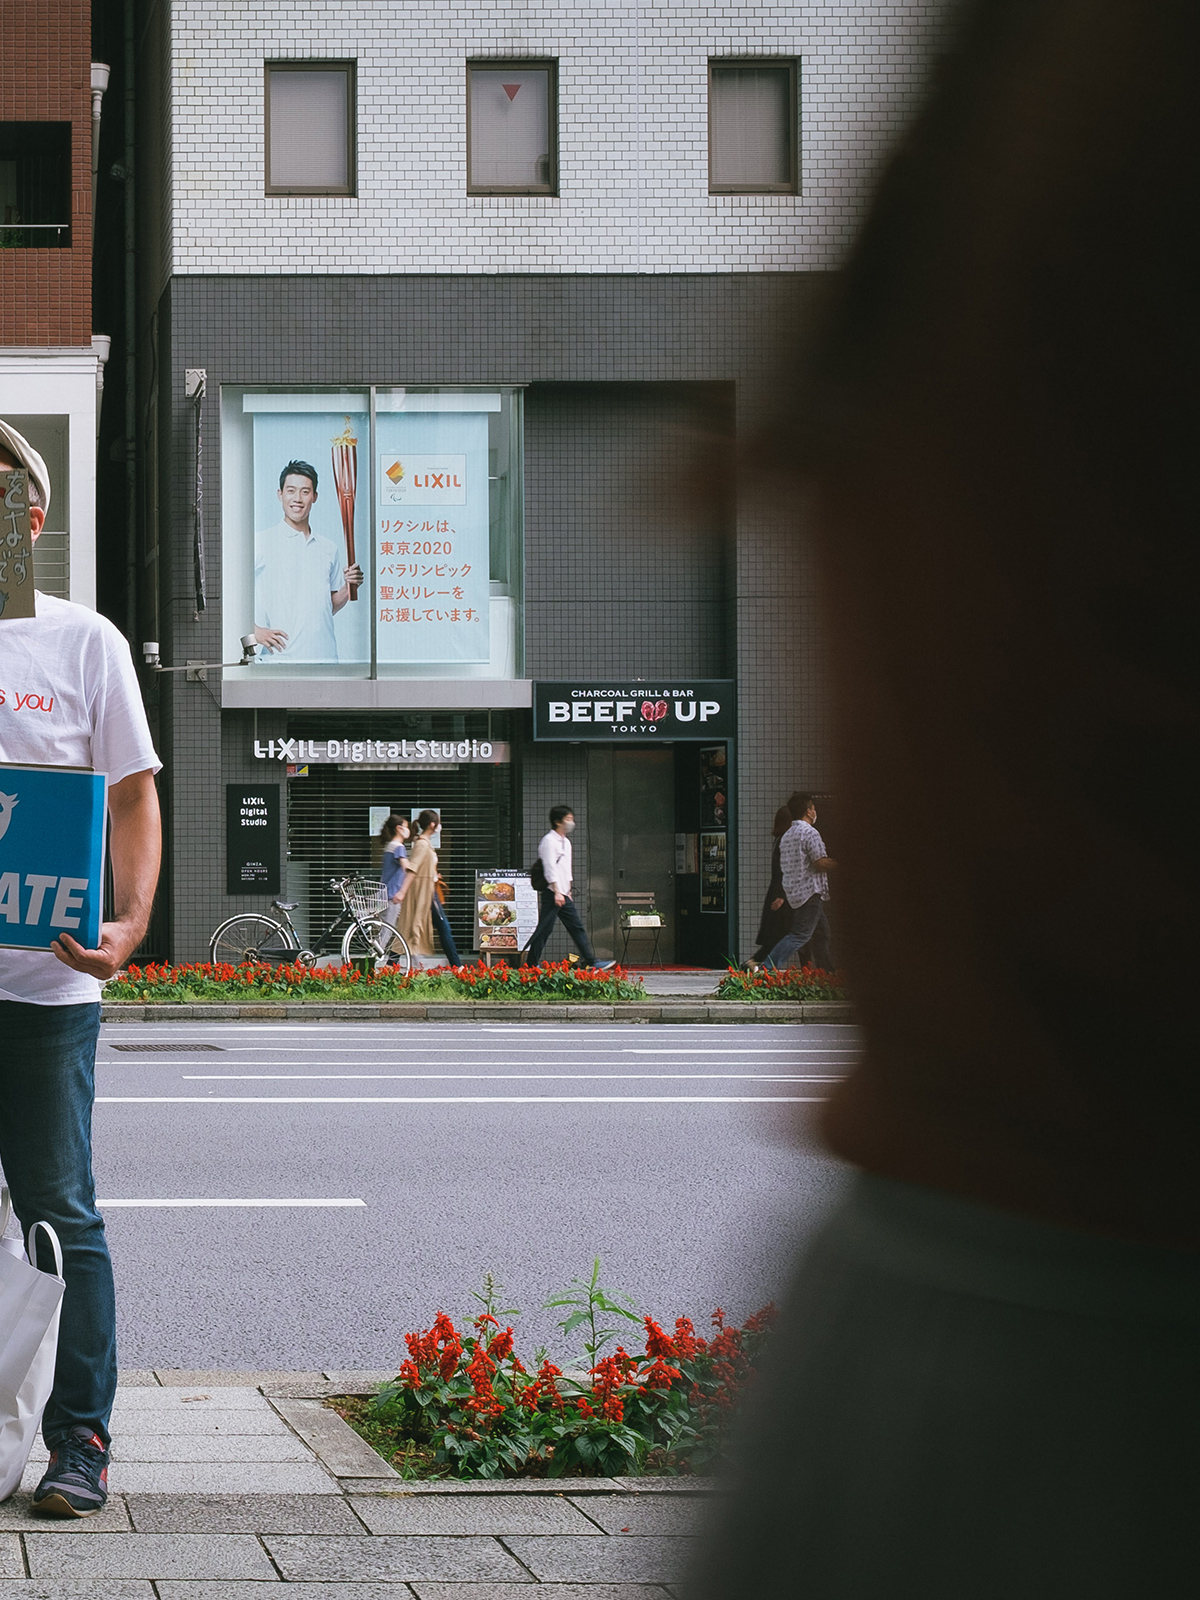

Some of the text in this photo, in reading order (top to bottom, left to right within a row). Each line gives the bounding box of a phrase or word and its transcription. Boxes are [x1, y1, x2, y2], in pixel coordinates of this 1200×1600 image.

[414, 473, 461, 489] LIXIL
[380, 519, 457, 534] リクシルは、
[380, 541, 453, 555] 東京2020
[380, 563, 473, 578] パラリンピック
[380, 586, 465, 600] 聖火リレーを
[379, 607, 481, 623] 応援しています。
[571, 689, 694, 698] CHARCOAL GRILL & BAR
[13, 692, 54, 713] you
[548, 700, 721, 723] BEEF UP
[611, 725, 658, 733] TOKYO
[253, 737, 493, 762] LIXIL Digital Studio
[242, 796, 266, 805] LIXIL
[240, 808, 268, 817] Digital
[240, 818, 267, 826] Studio
